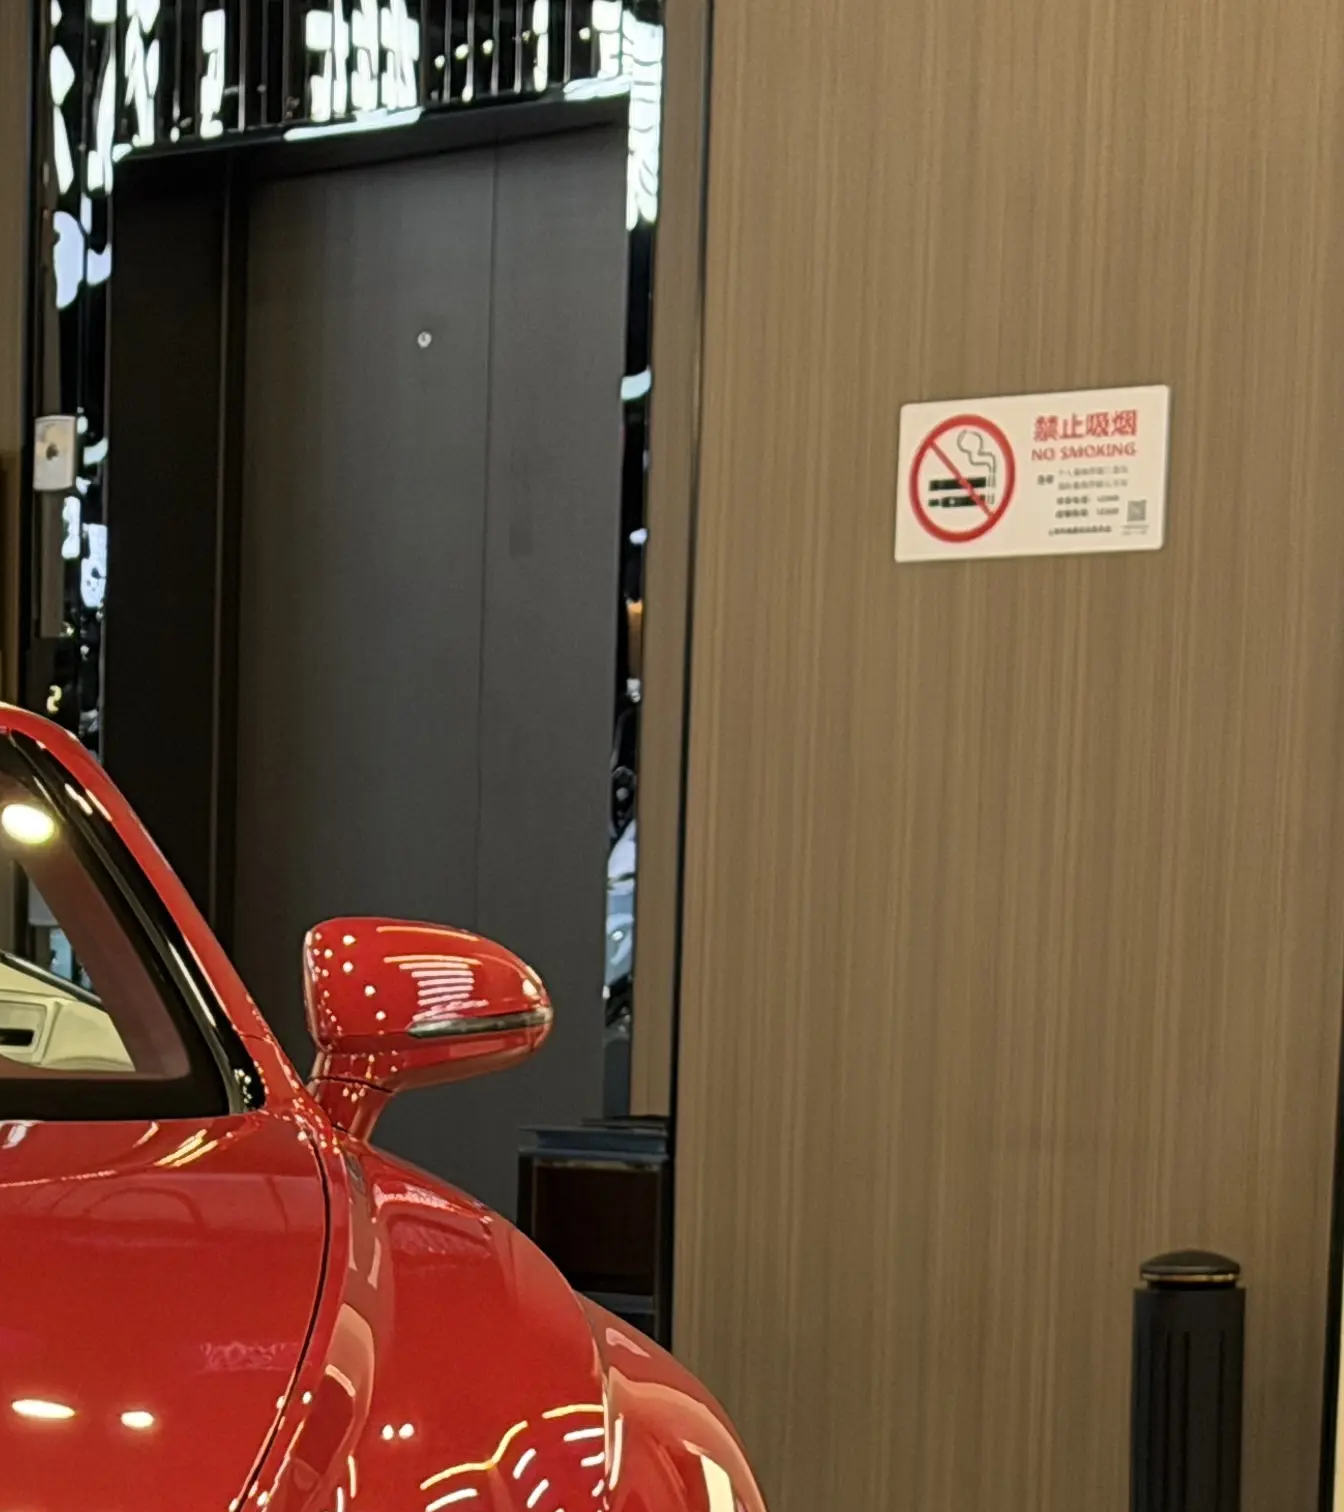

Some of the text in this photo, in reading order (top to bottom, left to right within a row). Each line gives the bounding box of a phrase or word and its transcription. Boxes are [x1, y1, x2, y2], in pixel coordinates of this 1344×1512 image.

[1033, 409, 1138, 442] 禁止吸烟
[1031, 442, 1138, 461] NO SMOKING
